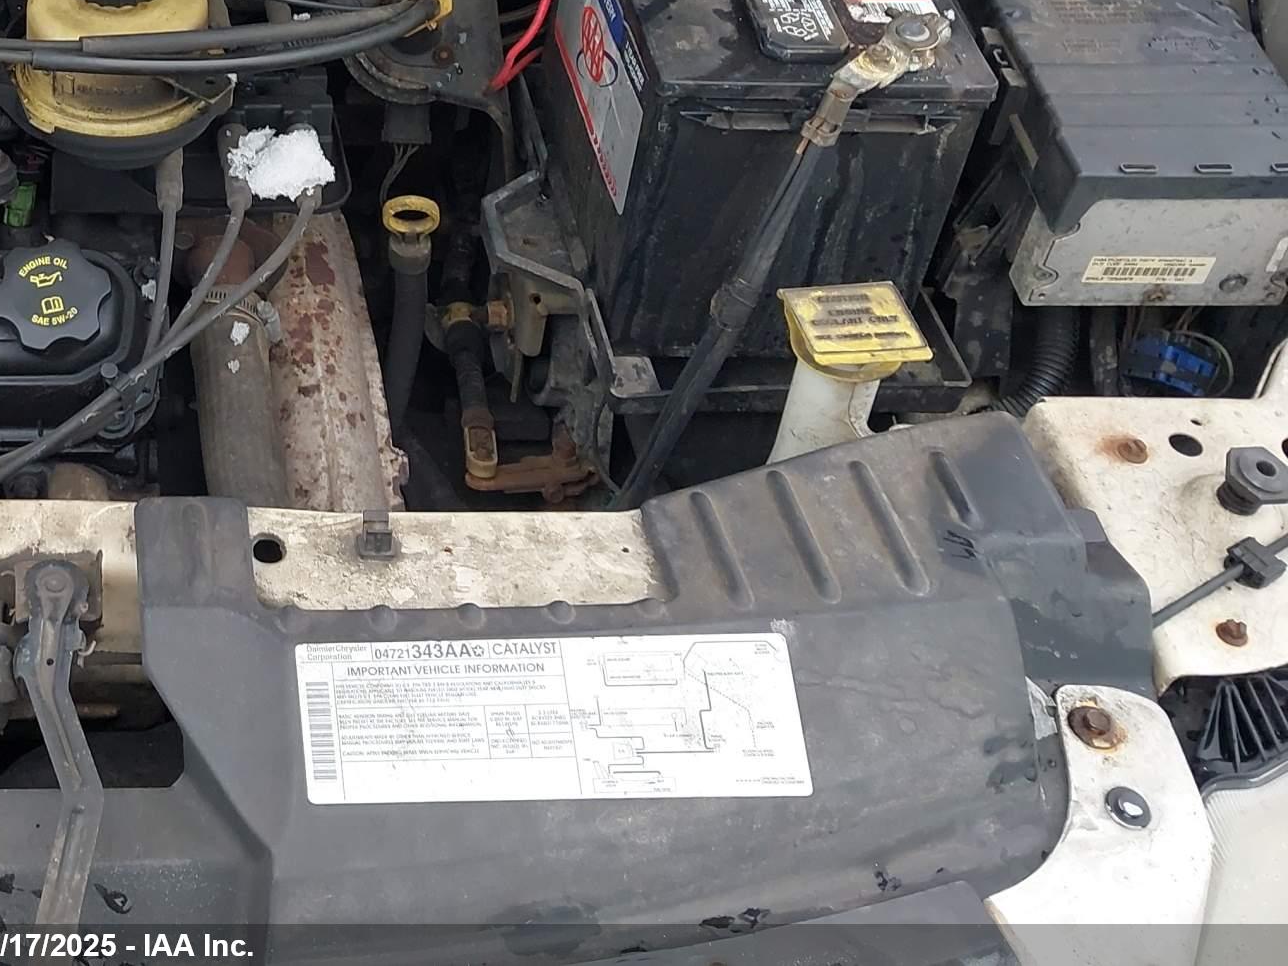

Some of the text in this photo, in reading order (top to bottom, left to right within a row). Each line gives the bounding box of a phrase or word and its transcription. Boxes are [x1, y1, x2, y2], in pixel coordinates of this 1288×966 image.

[18, 256, 69, 277] ENGINE OIL
[31, 306, 78, 326] SAE 5W-20
[492, 642, 558, 656] CATALYST
[306, 653, 353, 661] Corporation
[347, 663, 545, 676] IMPORTANT VEHICLE INFORMATION
